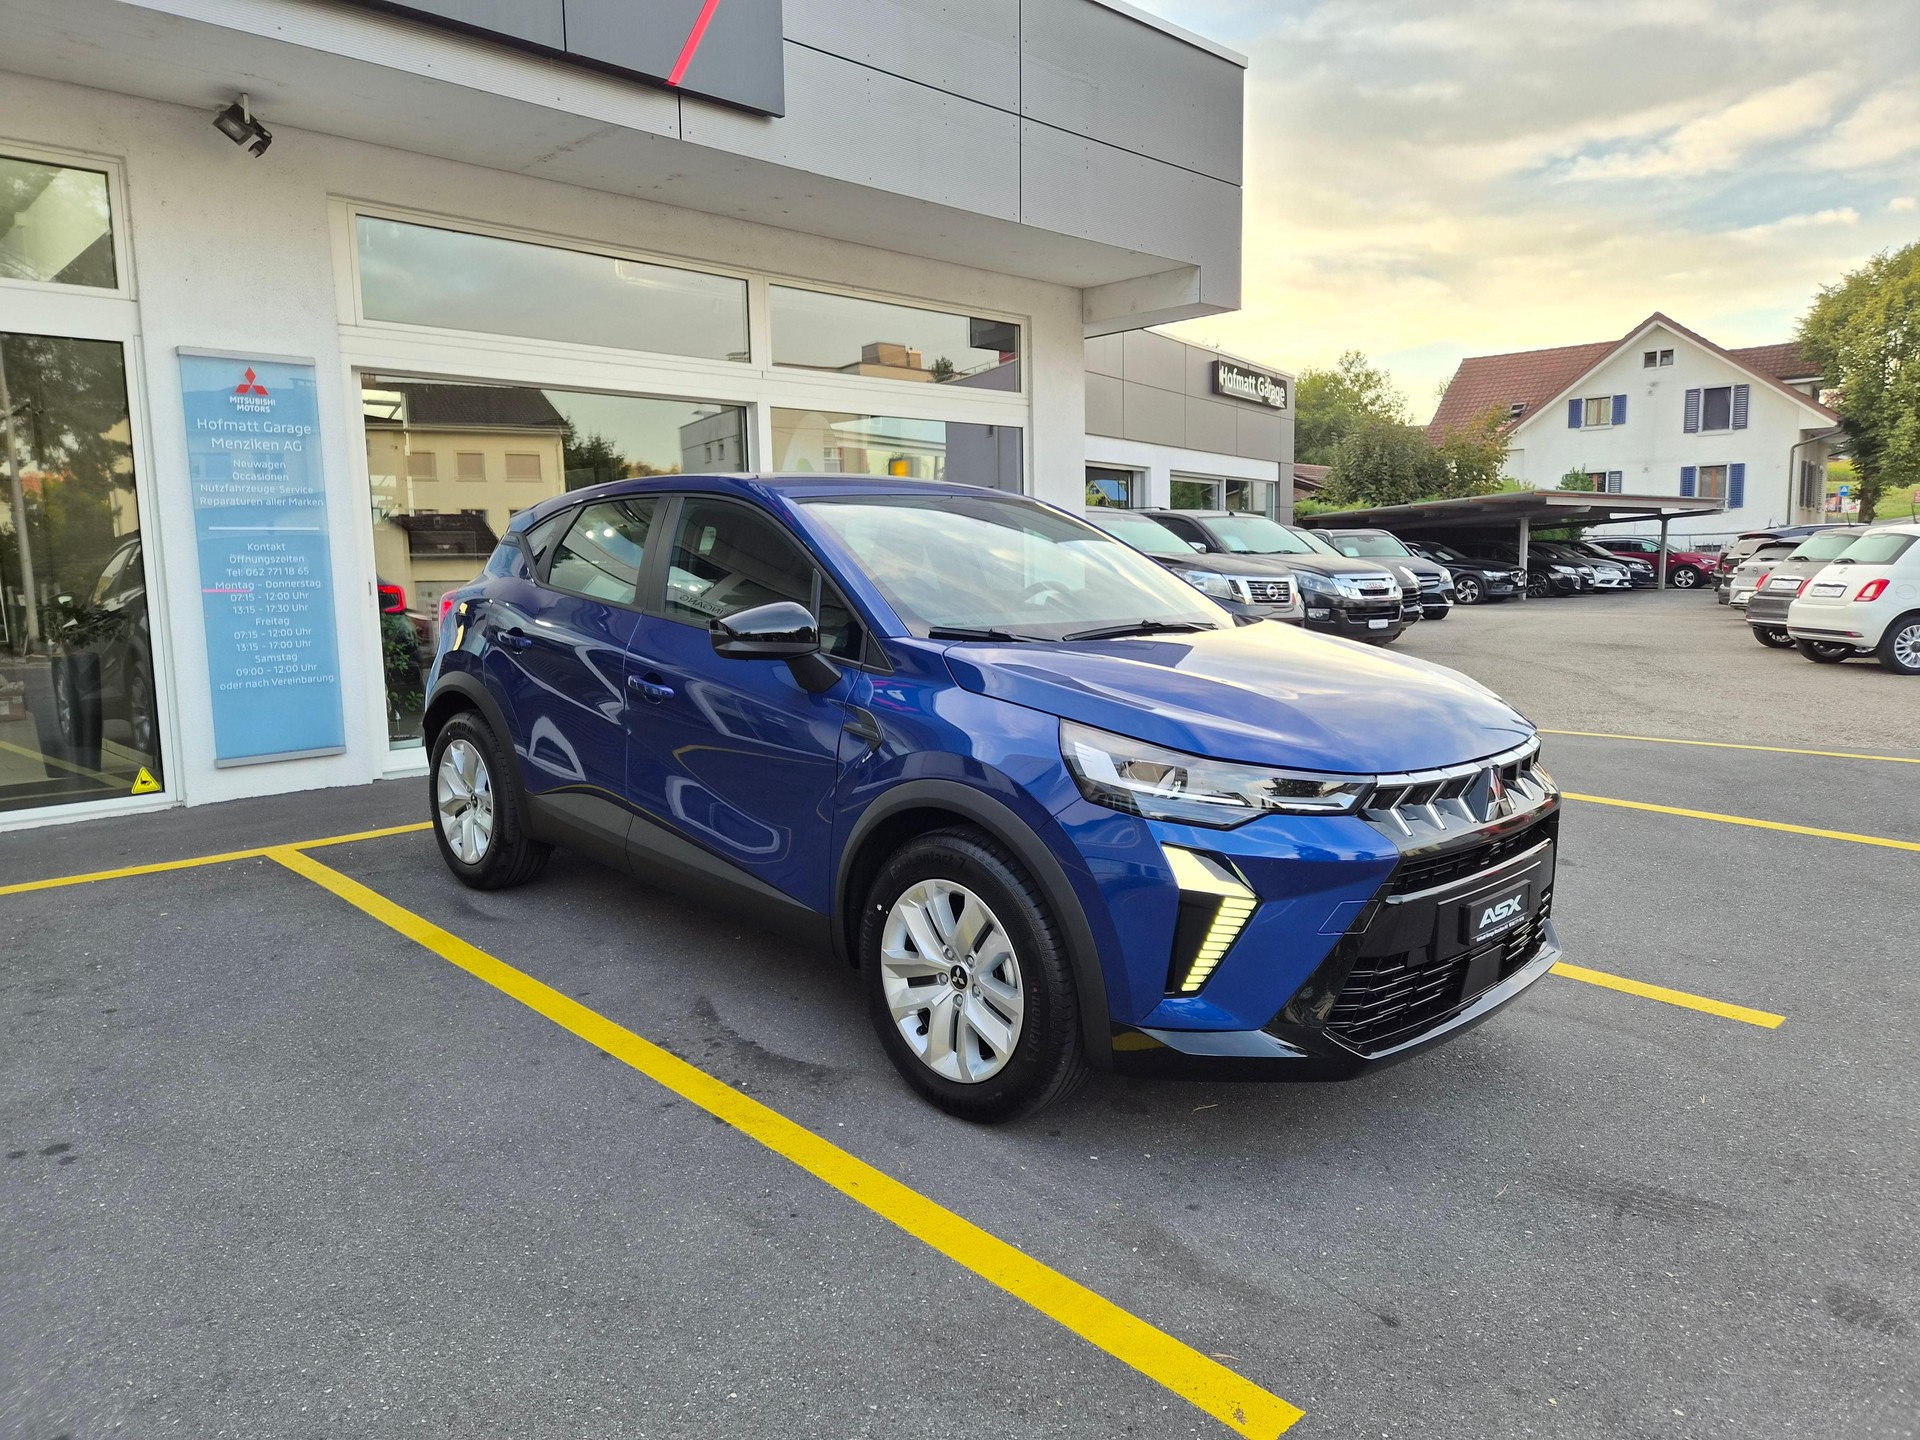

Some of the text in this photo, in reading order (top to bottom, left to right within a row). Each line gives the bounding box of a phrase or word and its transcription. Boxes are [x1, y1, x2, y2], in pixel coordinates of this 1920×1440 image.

[1221, 366, 1286, 406] Hofmatt Garage
[229, 396, 276, 406] MITSUBISHI
[236, 404, 271, 413] MOTORS
[197, 418, 312, 437] Hofmatt Garage
[211, 437, 302, 452] Menziken AG
[233, 459, 286, 470] Neuwagen
[232, 472, 289, 481] Occasionen
[200, 484, 314, 494] Nutzfahrzeuge Service
[200, 496, 324, 507] Reparaturen aller Marken
[247, 543, 286, 551] Kontakt
[229, 554, 305, 566] Öffnungszeiten
[246, 568, 264, 577] 062
[267, 567, 282, 576] 771
[285, 567, 295, 575] 18
[298, 567, 309, 575] 65
[215, 581, 255, 591] Montag
[265, 580, 321, 589] Donnerstag
[230, 593, 255, 602] 07:15
[265, 592, 290, 601] 12:00
[292, 592, 309, 600] Uhr
[233, 606, 256, 615] 13:15
[266, 604, 290, 613] 17:30
[292, 604, 309, 612] Uhr
[255, 617, 290, 627] Freitag
[234, 631, 258, 640] 07:15
[269, 629, 293, 637] 12:00
[295, 628, 312, 636] Uhr
[236, 643, 259, 652] 13:15
[269, 641, 293, 649] 17:00
[295, 640, 312, 648] Uhr
[255, 653, 298, 663] Samstag
[236, 667, 264, 677] 09:00
[274, 665, 299, 674] 12:00
[301, 663, 318, 671] Uhr
[219, 674, 334, 691] oder nach Vereinbarung
[1479, 894, 1522, 929] ASX
